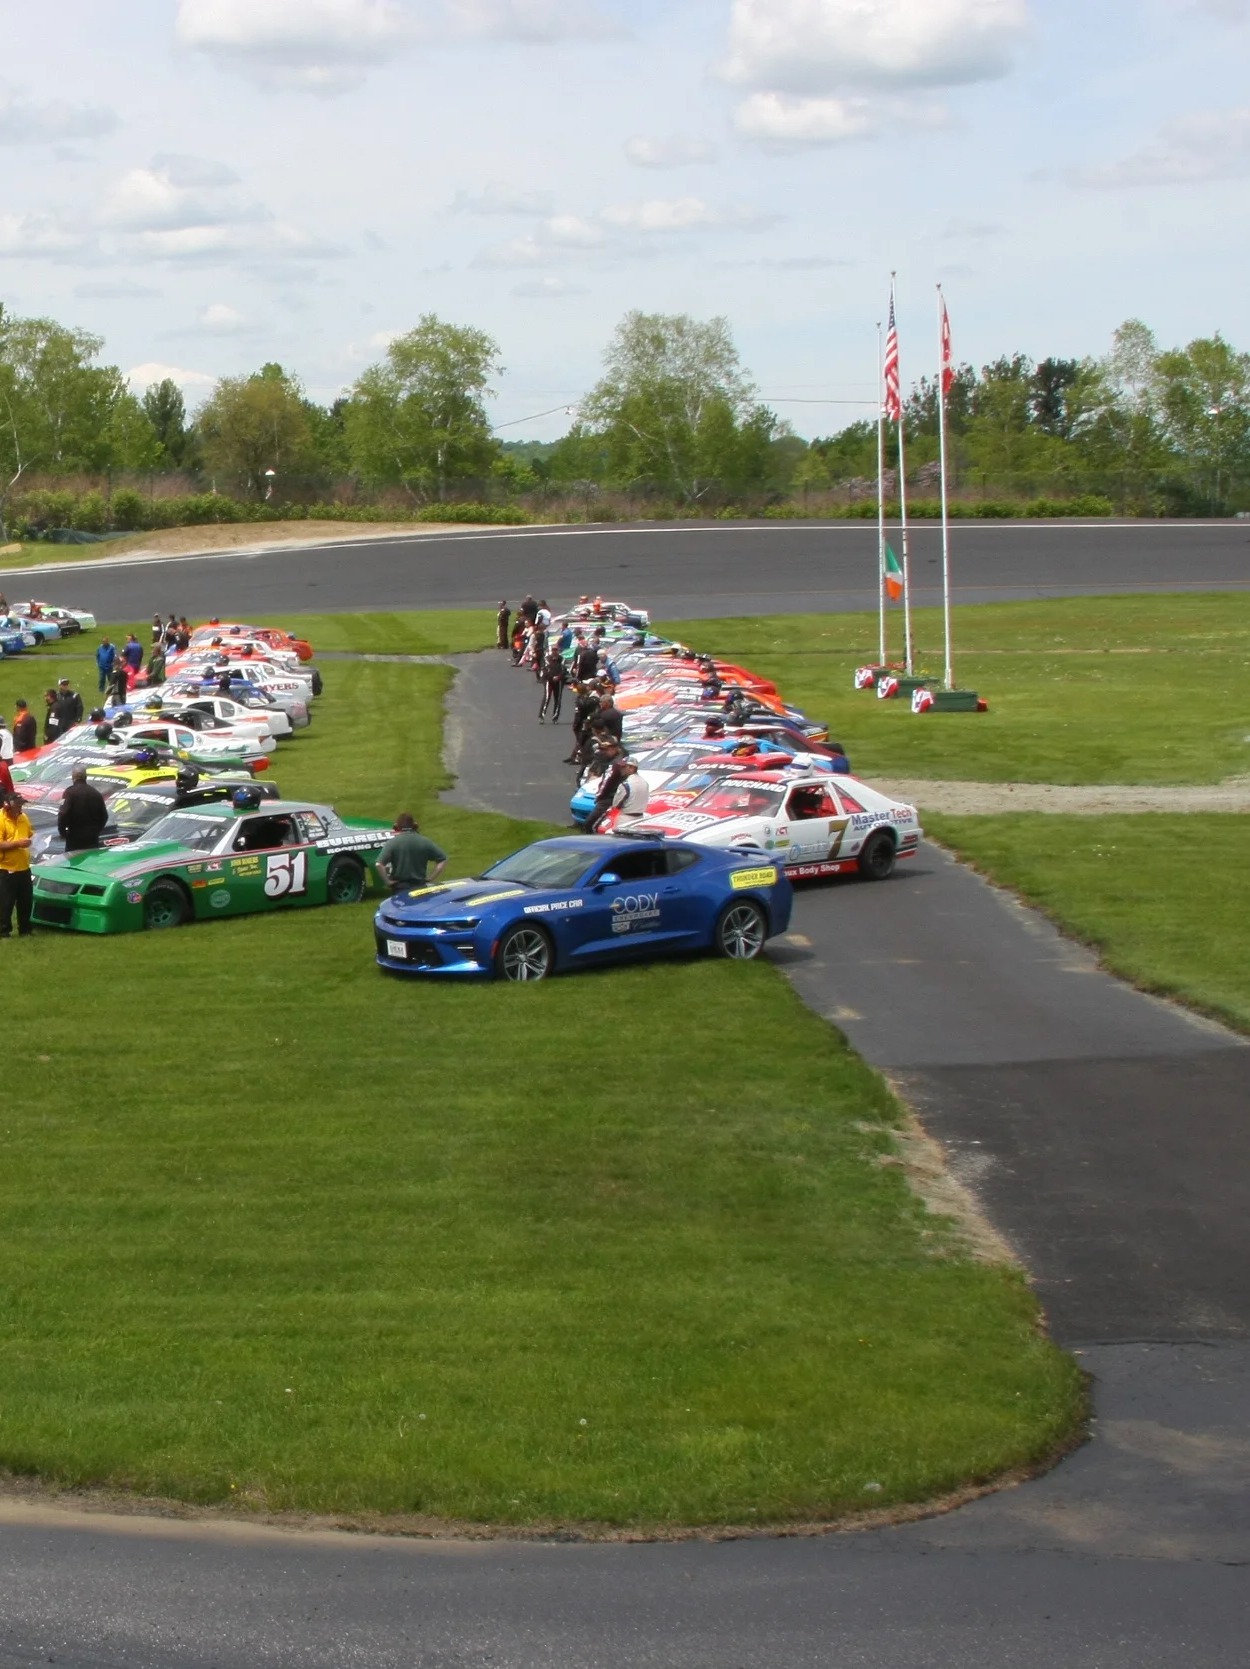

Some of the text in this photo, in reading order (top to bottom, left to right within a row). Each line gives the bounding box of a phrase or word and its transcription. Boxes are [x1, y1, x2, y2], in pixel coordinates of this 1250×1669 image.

[721, 779, 786, 793] BOUCHARD
[852, 808, 912, 825] Master Tech
[853, 818, 912, 831] AUTOMOTIVE
[316, 832, 395, 848] BURRELL
[828, 819, 850, 859] 7
[327, 842, 371, 854] ROOFING
[264, 851, 305, 896] 51
[733, 870, 774, 883] THUNDER ROAD
[799, 867, 818, 876] Body
[821, 864, 840, 873] Shop
[524, 899, 583, 914] OFFICIAL PACE CAR
[613, 892, 658, 914] CODY
